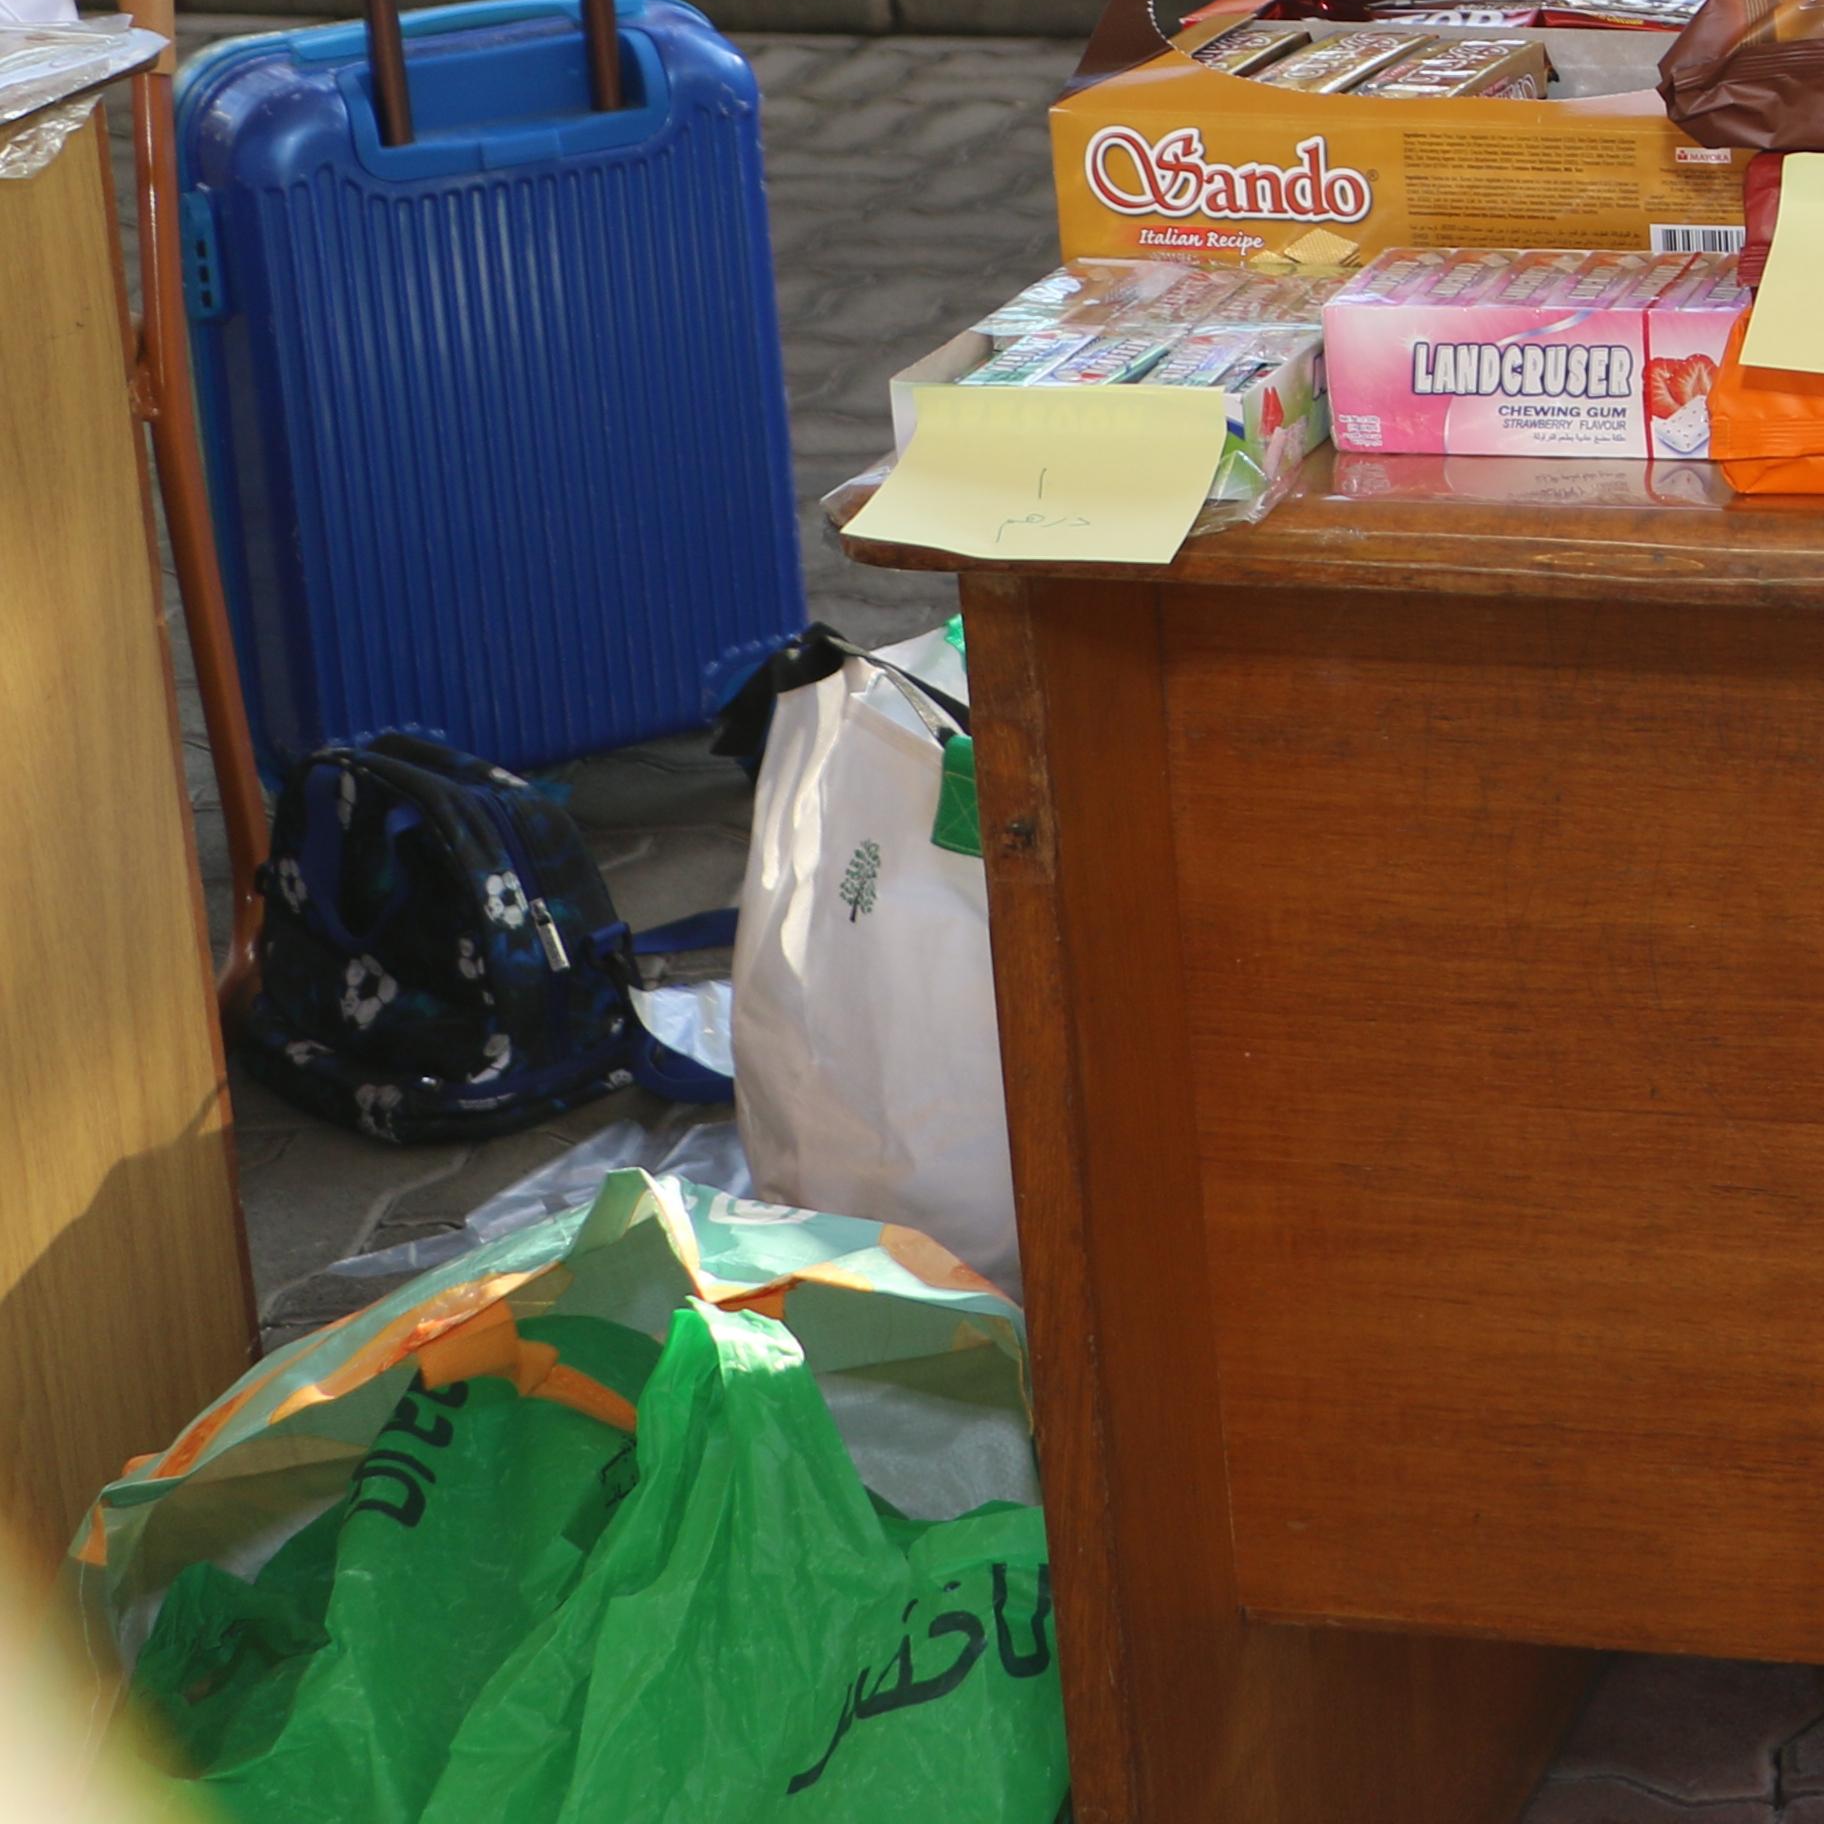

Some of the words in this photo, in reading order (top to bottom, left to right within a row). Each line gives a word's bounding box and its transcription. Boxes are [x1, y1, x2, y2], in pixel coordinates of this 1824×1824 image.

[1689, 152, 1731, 163] MAYORA
[1084, 125, 1373, 223] Sando
[1138, 228, 1203, 247] Italian
[1206, 230, 1265, 256] Recipe
[1413, 341, 1634, 399] LANDCRUSER
[1498, 405, 1581, 418] CHEWING
[1586, 406, 1627, 418] GUM
[1503, 418, 1574, 429] STRAWBERRY
[1579, 419, 1627, 431] FLAVOUR
